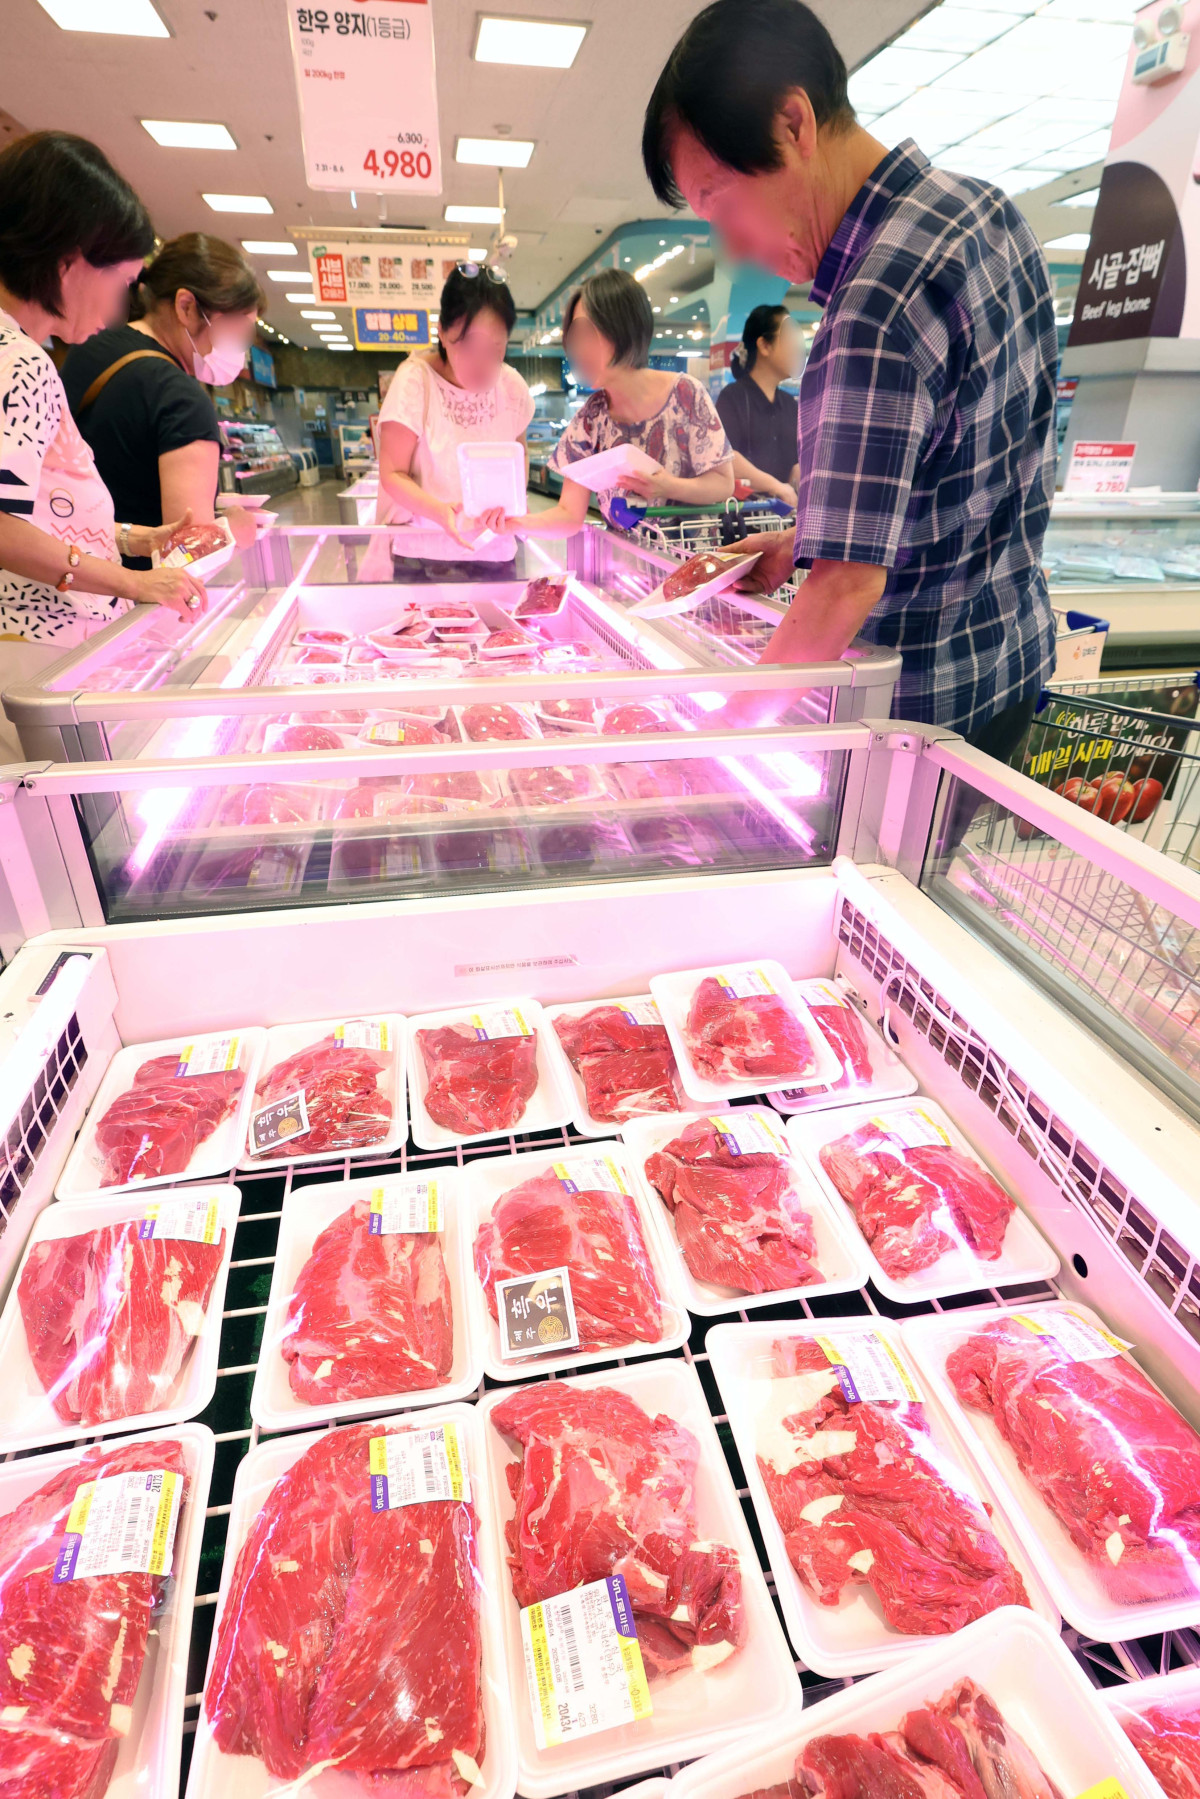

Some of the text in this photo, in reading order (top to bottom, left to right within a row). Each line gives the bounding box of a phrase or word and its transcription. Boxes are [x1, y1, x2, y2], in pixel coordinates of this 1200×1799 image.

[297, 8, 411, 40] 한우 양지(1등급)
[312, 69, 332, 80] 200kg
[363, 149, 432, 179] 4,980
[1081, 296, 1151, 321] Beef leg bone
[1029, 745, 1073, 776] 매일
[151, 1474, 163, 1494] 24173
[375, 1476, 383, 1509] 하나로마트
[57, 1534, 77, 1579] 하나로마트
[536, 1605, 544, 1629] 이력번호
[545, 1603, 554, 1637] 2025.08.04
[611, 1577, 631, 1636] 하나로마트
[557, 1703, 572, 1733] 20434
[577, 1711, 587, 1728] 623
[588, 1703, 599, 1725] 3280
